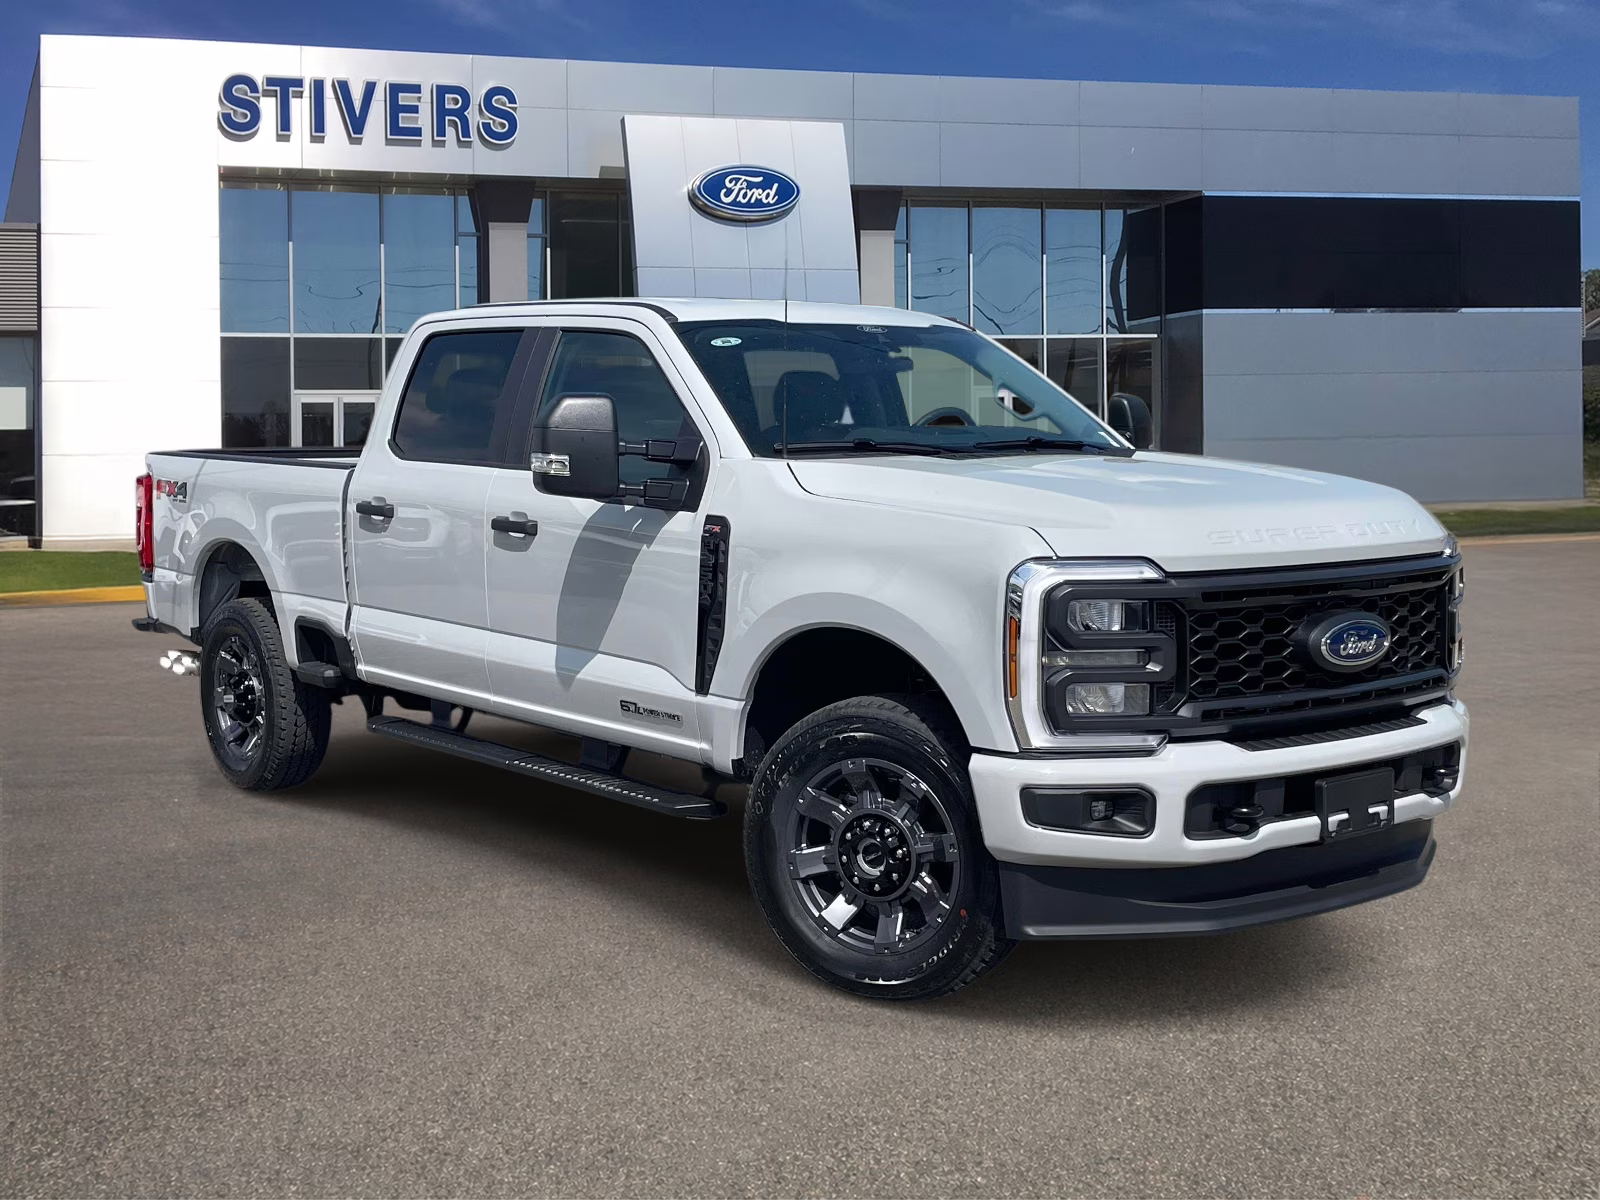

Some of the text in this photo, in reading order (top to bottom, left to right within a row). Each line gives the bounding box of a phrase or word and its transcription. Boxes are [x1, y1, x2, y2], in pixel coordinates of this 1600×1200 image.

[218, 72, 519, 146] STIVERS
[720, 174, 779, 204] Ford
[1340, 629, 1378, 656] Ford
